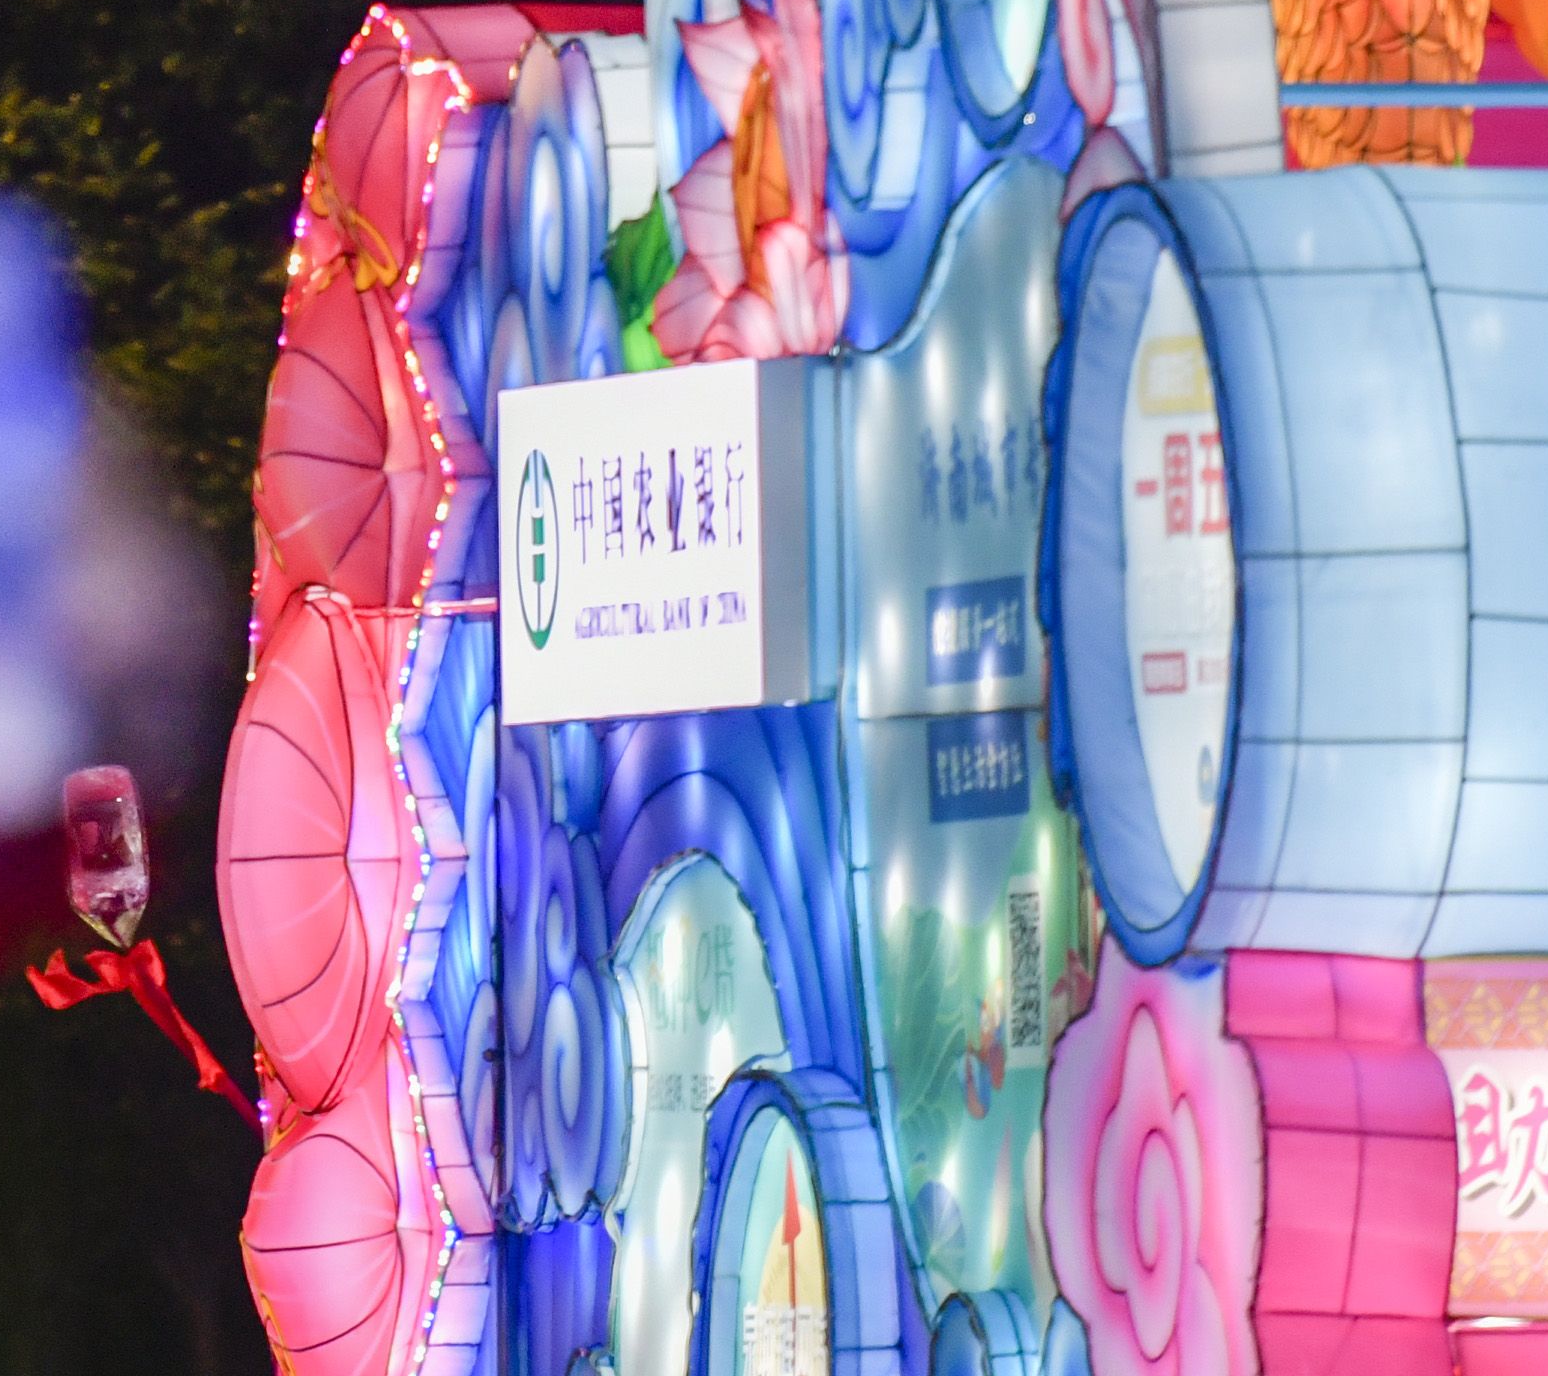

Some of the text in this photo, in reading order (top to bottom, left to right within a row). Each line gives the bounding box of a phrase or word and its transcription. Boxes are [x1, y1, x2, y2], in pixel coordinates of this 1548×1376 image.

[573, 441, 745, 564] 中国农业银行
